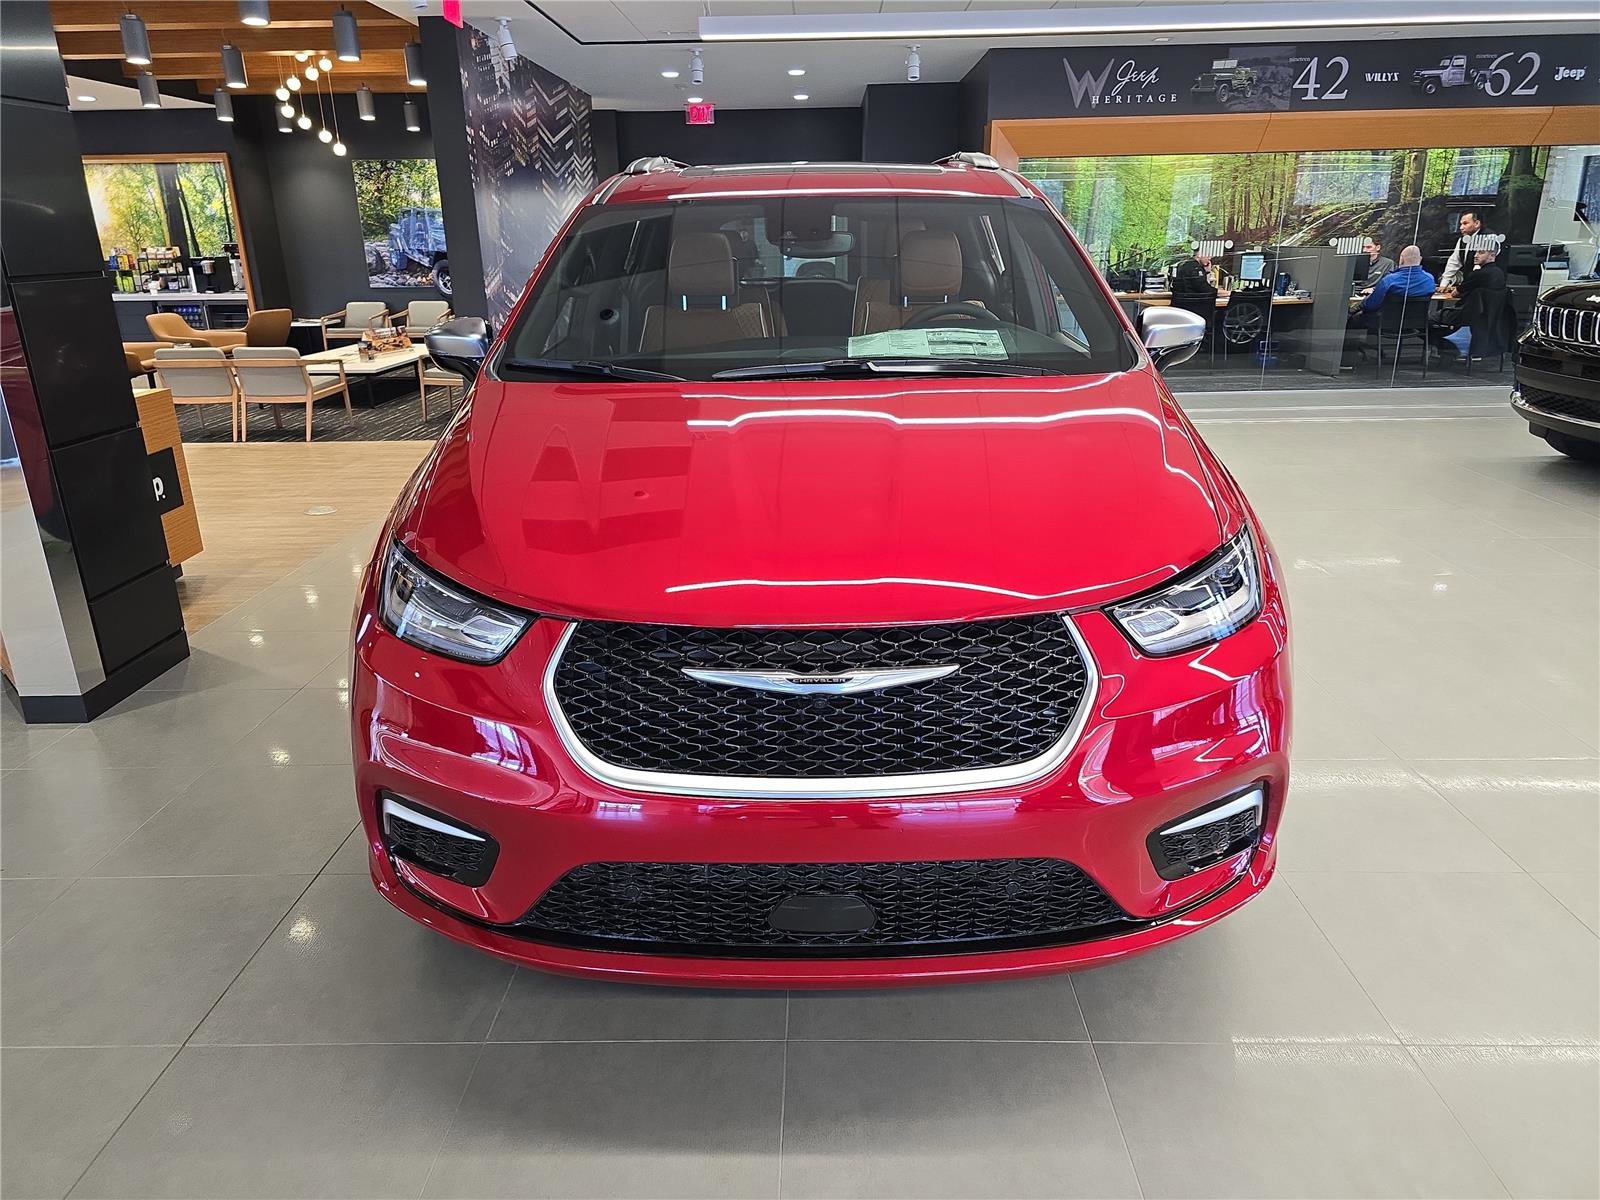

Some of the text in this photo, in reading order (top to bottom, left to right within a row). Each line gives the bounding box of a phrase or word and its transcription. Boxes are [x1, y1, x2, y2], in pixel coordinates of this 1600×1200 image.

[1111, 60, 1160, 97] Jeep
[1292, 56, 1350, 101] 42
[1364, 72, 1400, 82] WILLYS
[1484, 51, 1541, 97] 62
[1554, 66, 1587, 81] Jeep
[1091, 93, 1178, 105] HERITAGE
